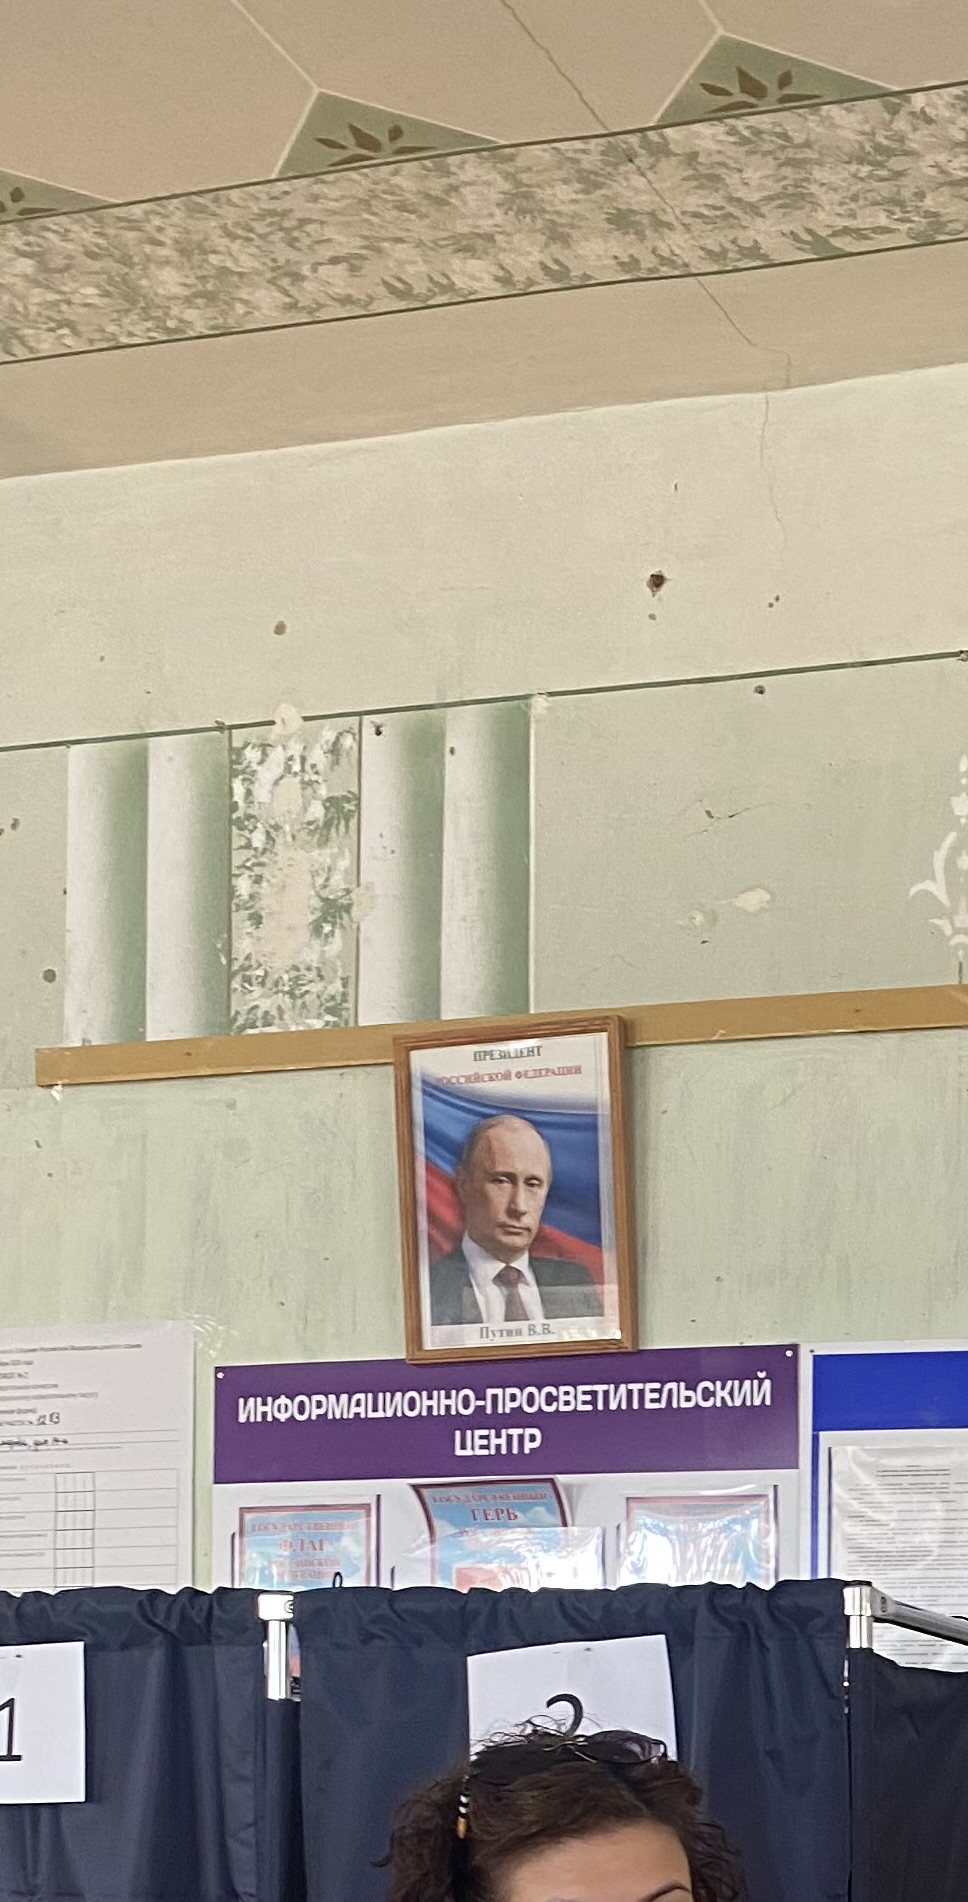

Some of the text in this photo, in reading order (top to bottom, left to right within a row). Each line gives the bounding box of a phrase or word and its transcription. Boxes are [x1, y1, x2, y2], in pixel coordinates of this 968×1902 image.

[473, 1045, 542, 1062] ПРЕЗИДЕНТ
[431, 1065, 582, 1086] РОССИЙСКОЙ ФЕДЕРАЦИИ
[480, 1323, 556, 1341] Путин В.В.
[237, 1371, 772, 1423] ИНФОРМАЦИОННО-ПРОСВЕТИТЕЛЬСКИЙ
[454, 1428, 542, 1457] ЦЕНТР
[470, 1507, 518, 1522] ГЕРБ
[279, 1538, 326, 1553] ФЛАГ
[0, 1697, 22, 1762] 1
